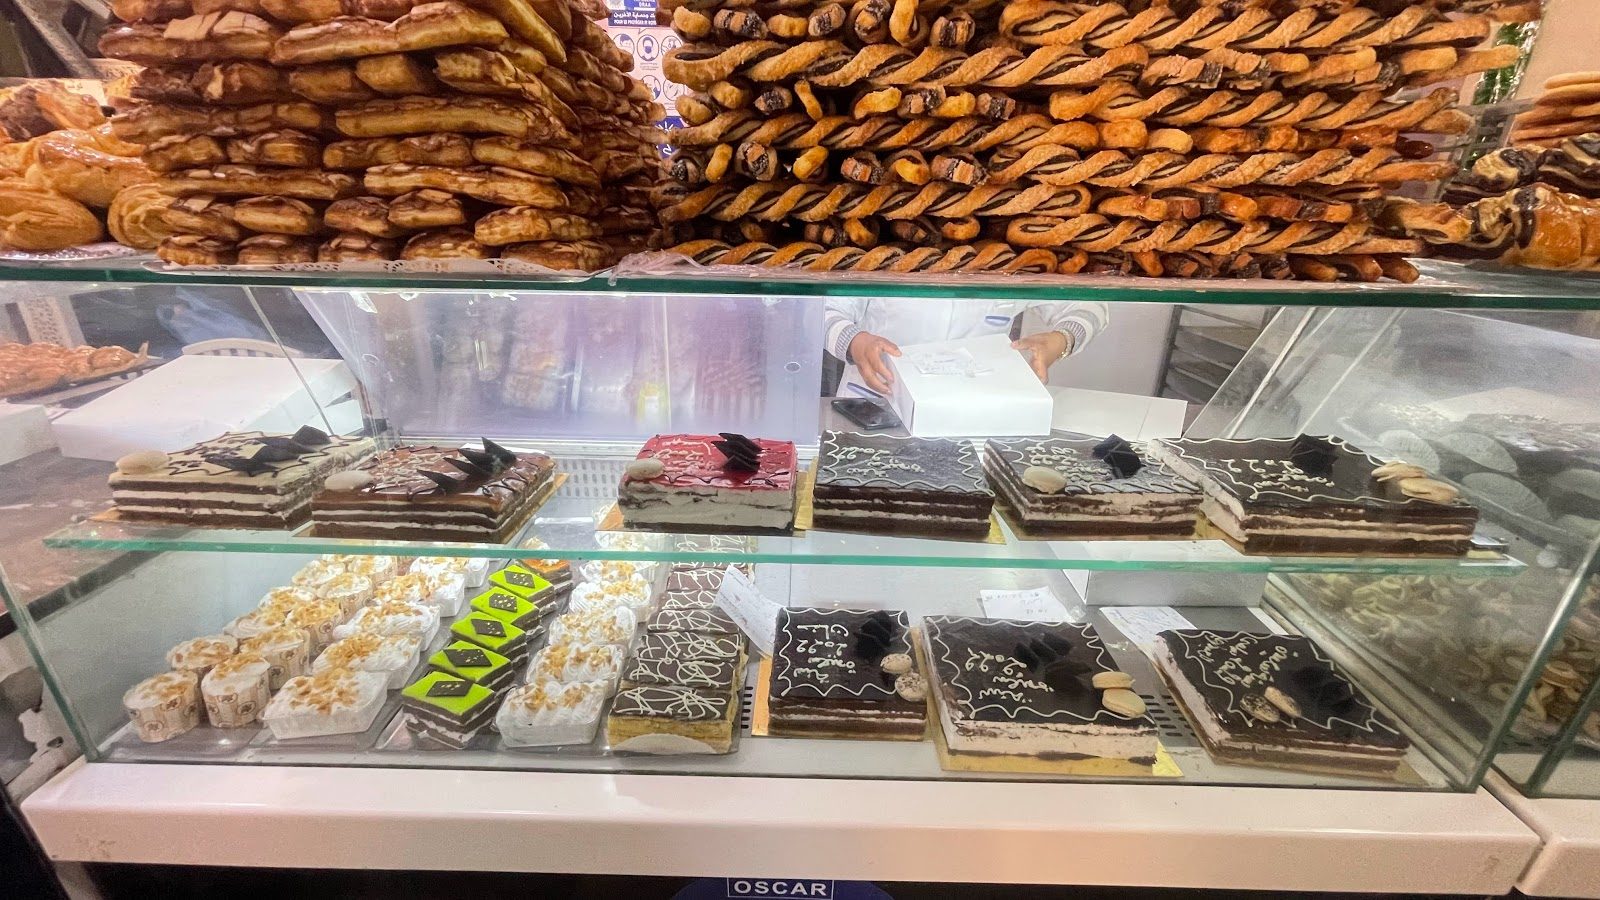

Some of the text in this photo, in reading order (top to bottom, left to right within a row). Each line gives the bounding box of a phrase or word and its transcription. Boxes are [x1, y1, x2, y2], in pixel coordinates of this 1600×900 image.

[1219, 459, 1304, 474] 2022
[796, 639, 848, 656] 2022
[807, 655, 857, 674] سعيدة
[965, 647, 1027, 676] 2022
[793, 667, 830, 684] سنة
[978, 687, 1033, 703] سنة
[733, 880, 827, 896] OSCAR
